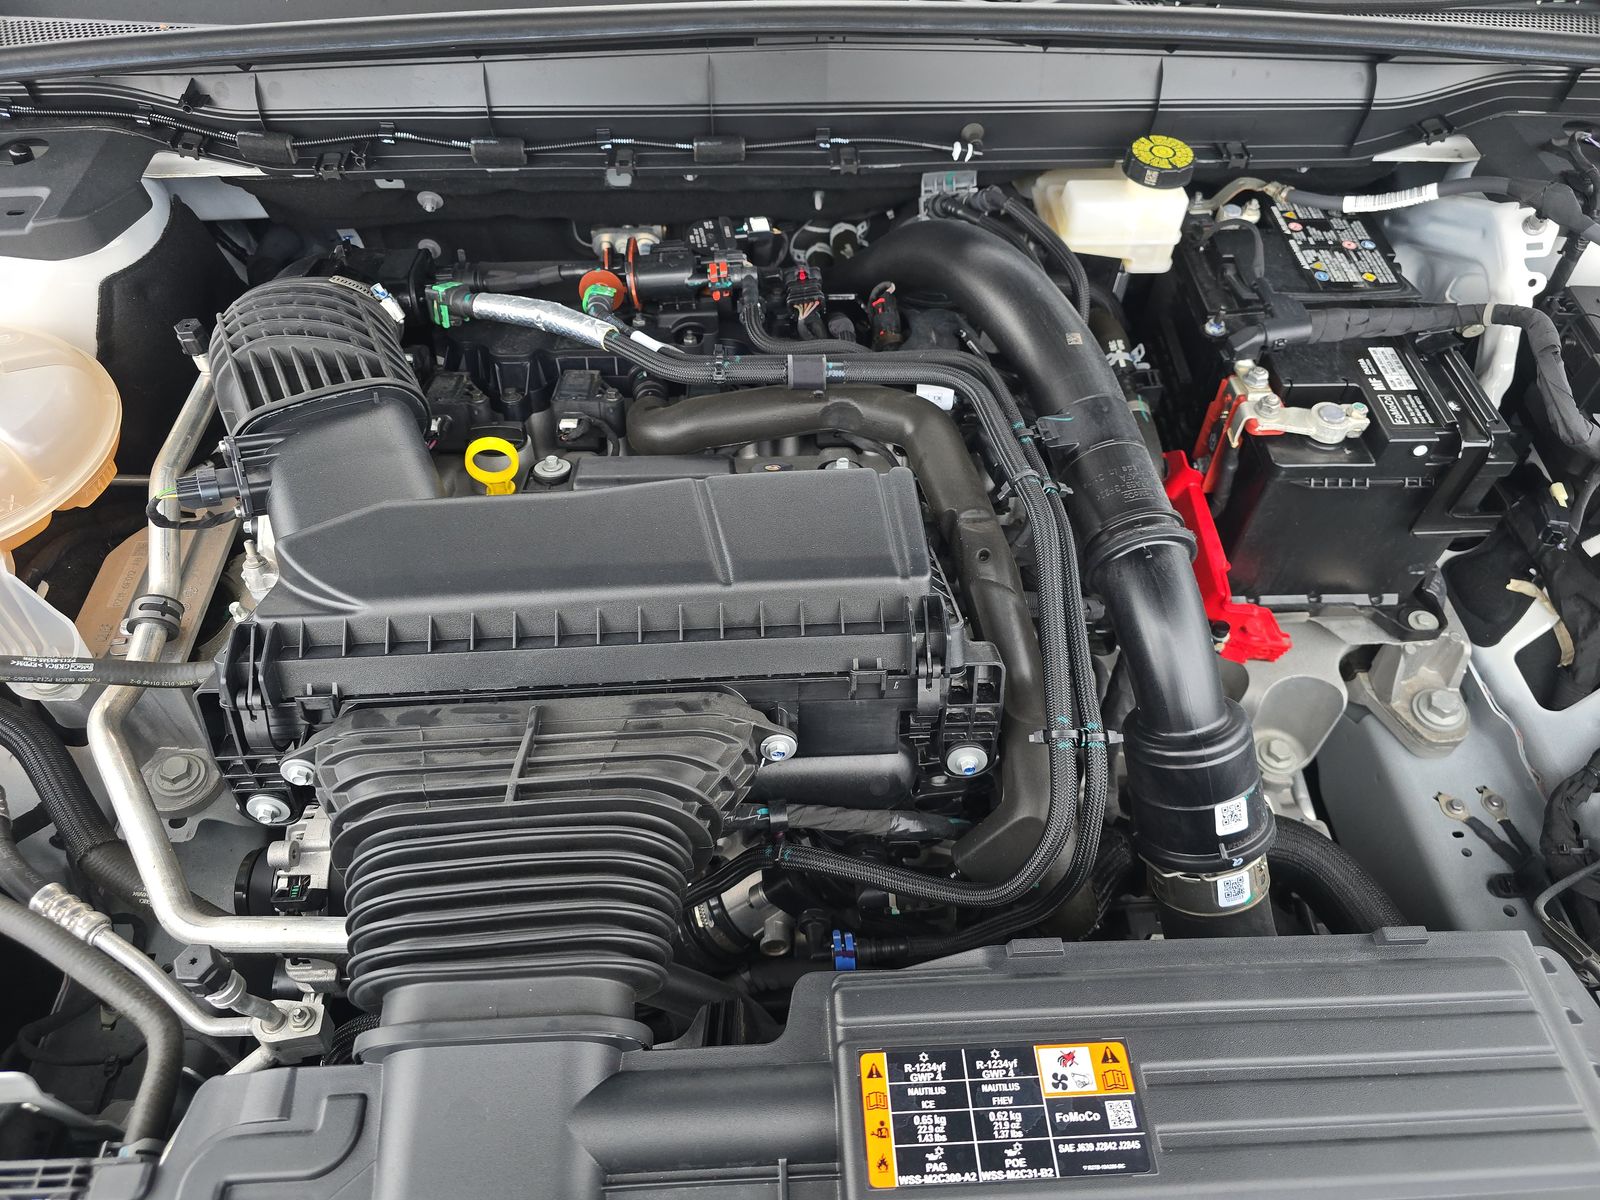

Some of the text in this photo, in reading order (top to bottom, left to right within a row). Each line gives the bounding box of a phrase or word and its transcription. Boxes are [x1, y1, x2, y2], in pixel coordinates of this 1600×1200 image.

[1383, 395, 1405, 423] FoMoCo
[904, 1062, 946, 1073] R-1234yf
[976, 1058, 1018, 1070] R-1234yf
[910, 1072, 943, 1082] GWP 4
[982, 1068, 1014, 1079] GWP 4
[908, 1086, 946, 1096] NAUTILUS
[982, 1082, 1020, 1092] NAUTILUS
[921, 1100, 936, 1109] ICE
[992, 1096, 1014, 1105] FHEV
[914, 1114, 946, 1126] 0.65 kg
[989, 1110, 1022, 1122] 0.62 kg
[1055, 1111, 1100, 1122] FoMoCo
[917, 1125, 934, 1134] 22.9
[992, 1122, 1010, 1130] 21.9
[917, 1133, 948, 1142] 1.43 lbs
[993, 1130, 1024, 1139] 1.37 lbs
[1058, 1144, 1076, 1153] SAE
[926, 1162, 948, 1172] PAG
[1005, 1158, 1027, 1168] POE
